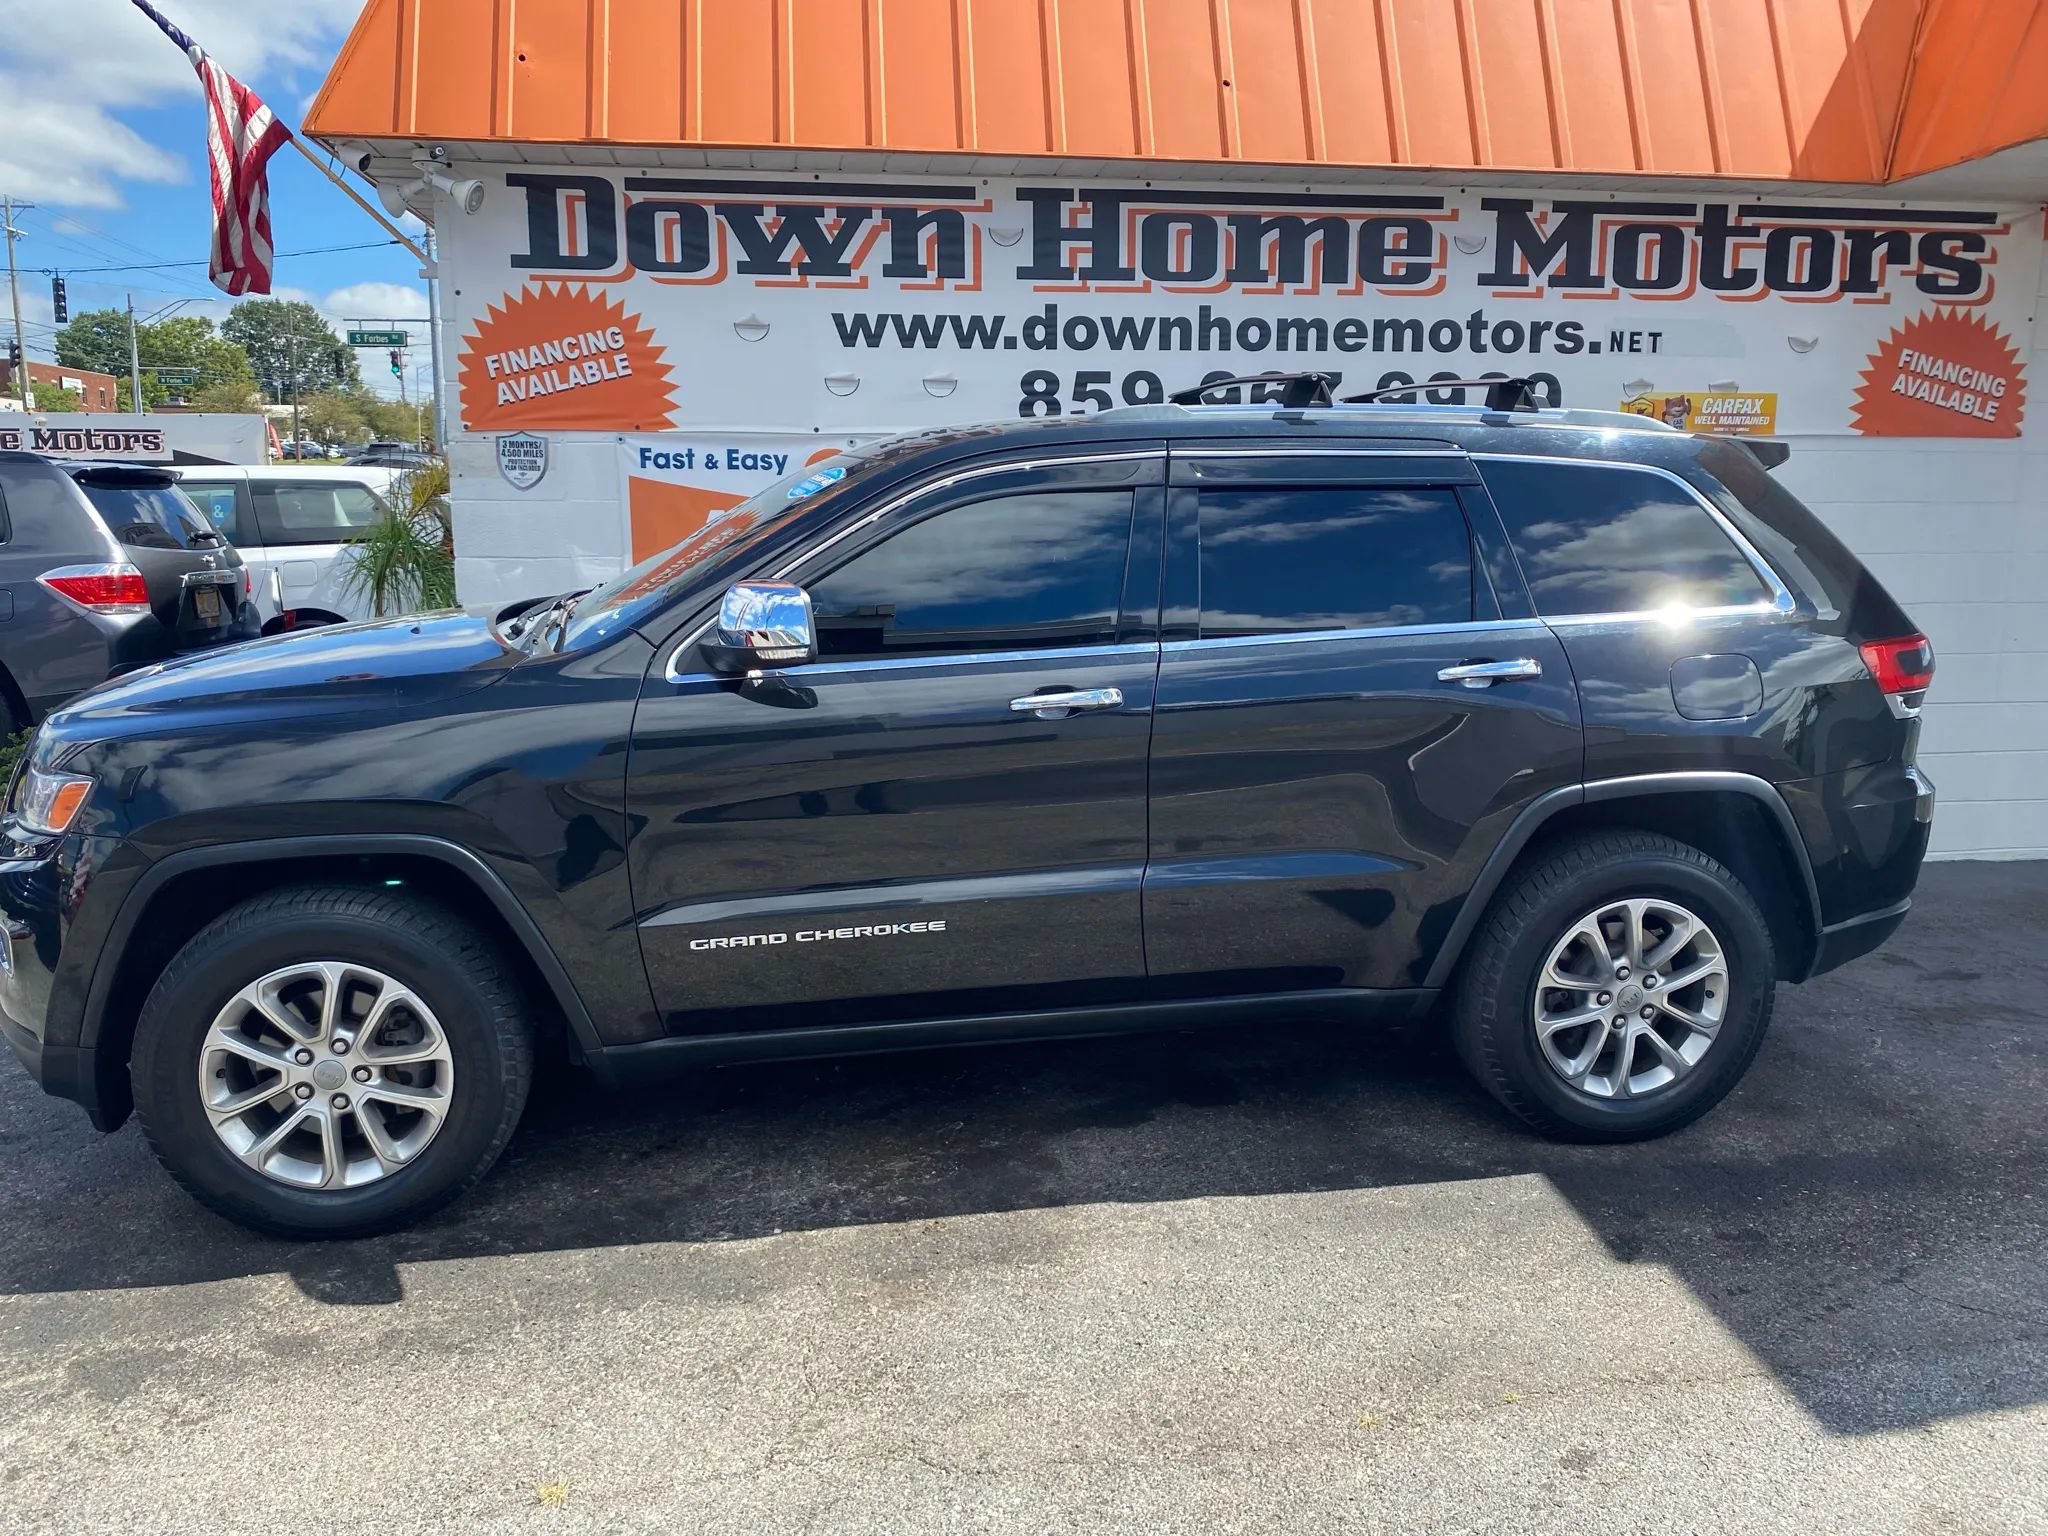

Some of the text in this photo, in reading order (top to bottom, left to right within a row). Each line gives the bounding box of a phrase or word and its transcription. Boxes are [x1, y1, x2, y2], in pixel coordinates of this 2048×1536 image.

[506, 172, 2003, 302] Down Home Motors
[355, 334, 361, 343] S
[364, 334, 389, 343] Forbes
[485, 326, 625, 380] FINANCING
[498, 353, 633, 406] AVAILABLE
[1898, 348, 2008, 399] FINANCING
[1701, 397, 1765, 414] CARFAX
[1891, 373, 2000, 423] AVAILABLE
[1694, 415, 1770, 425] WELL MAINTAINED
[29, 428, 163, 452] Motors
[502, 440, 508, 448] 3
[523, 449, 544, 458] MILES
[639, 448, 788, 476] Fast & Easy
[689, 920, 946, 951] GRAND CHEROKEE
